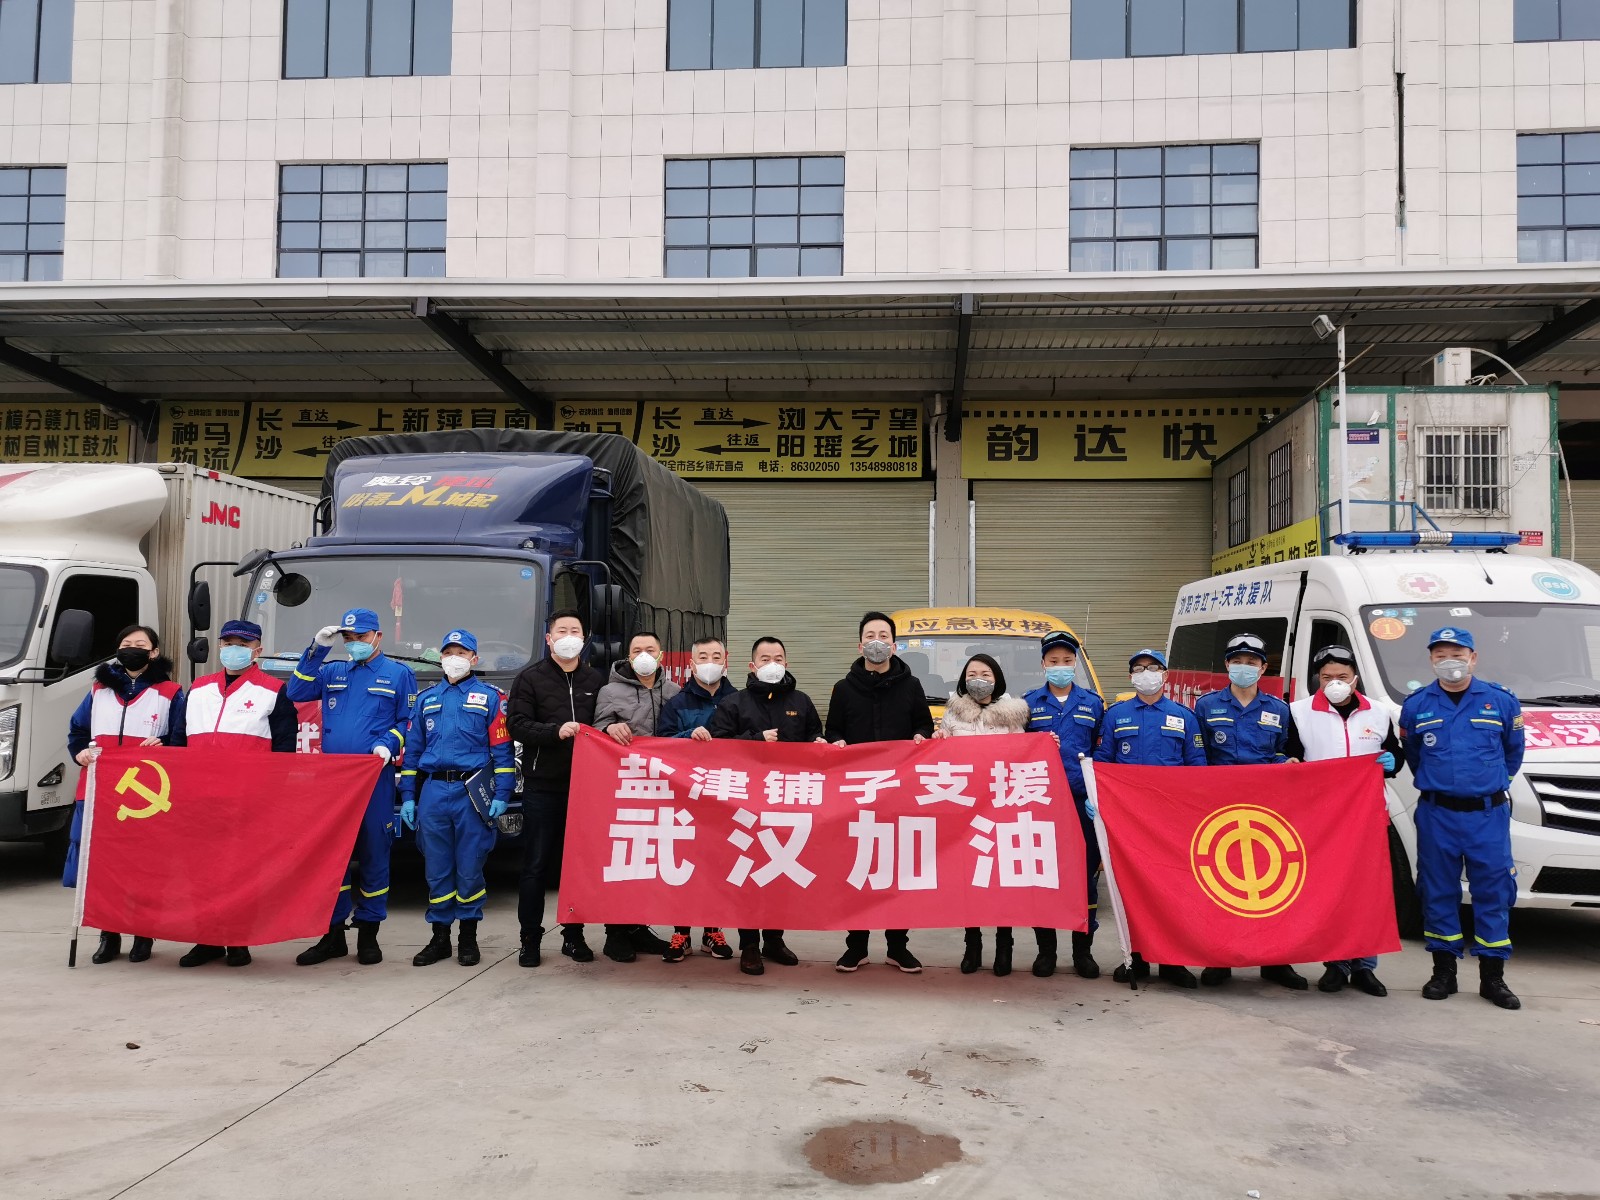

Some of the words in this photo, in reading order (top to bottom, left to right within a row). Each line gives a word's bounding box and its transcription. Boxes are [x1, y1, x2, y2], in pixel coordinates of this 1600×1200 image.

[298, 409, 329, 422] 直达
[700, 408, 734, 421] 直达
[171, 422, 231, 446] 神马
[255, 408, 283, 459] 长沙
[651, 407, 681, 457] 长沙
[726, 433, 760, 447] 往返
[986, 422, 1218, 462] 韵达快
[171, 447, 230, 471] 物流
[790, 461, 840, 472] 86302050
[849, 461, 918, 472] 13548980818
[202, 500, 240, 529] JMC
[907, 617, 1053, 633] 应急救援
[1382, 623, 1394, 635] 1
[614, 753, 1053, 809] 盐津铺子支援
[602, 806, 1061, 892] 武汉加油
